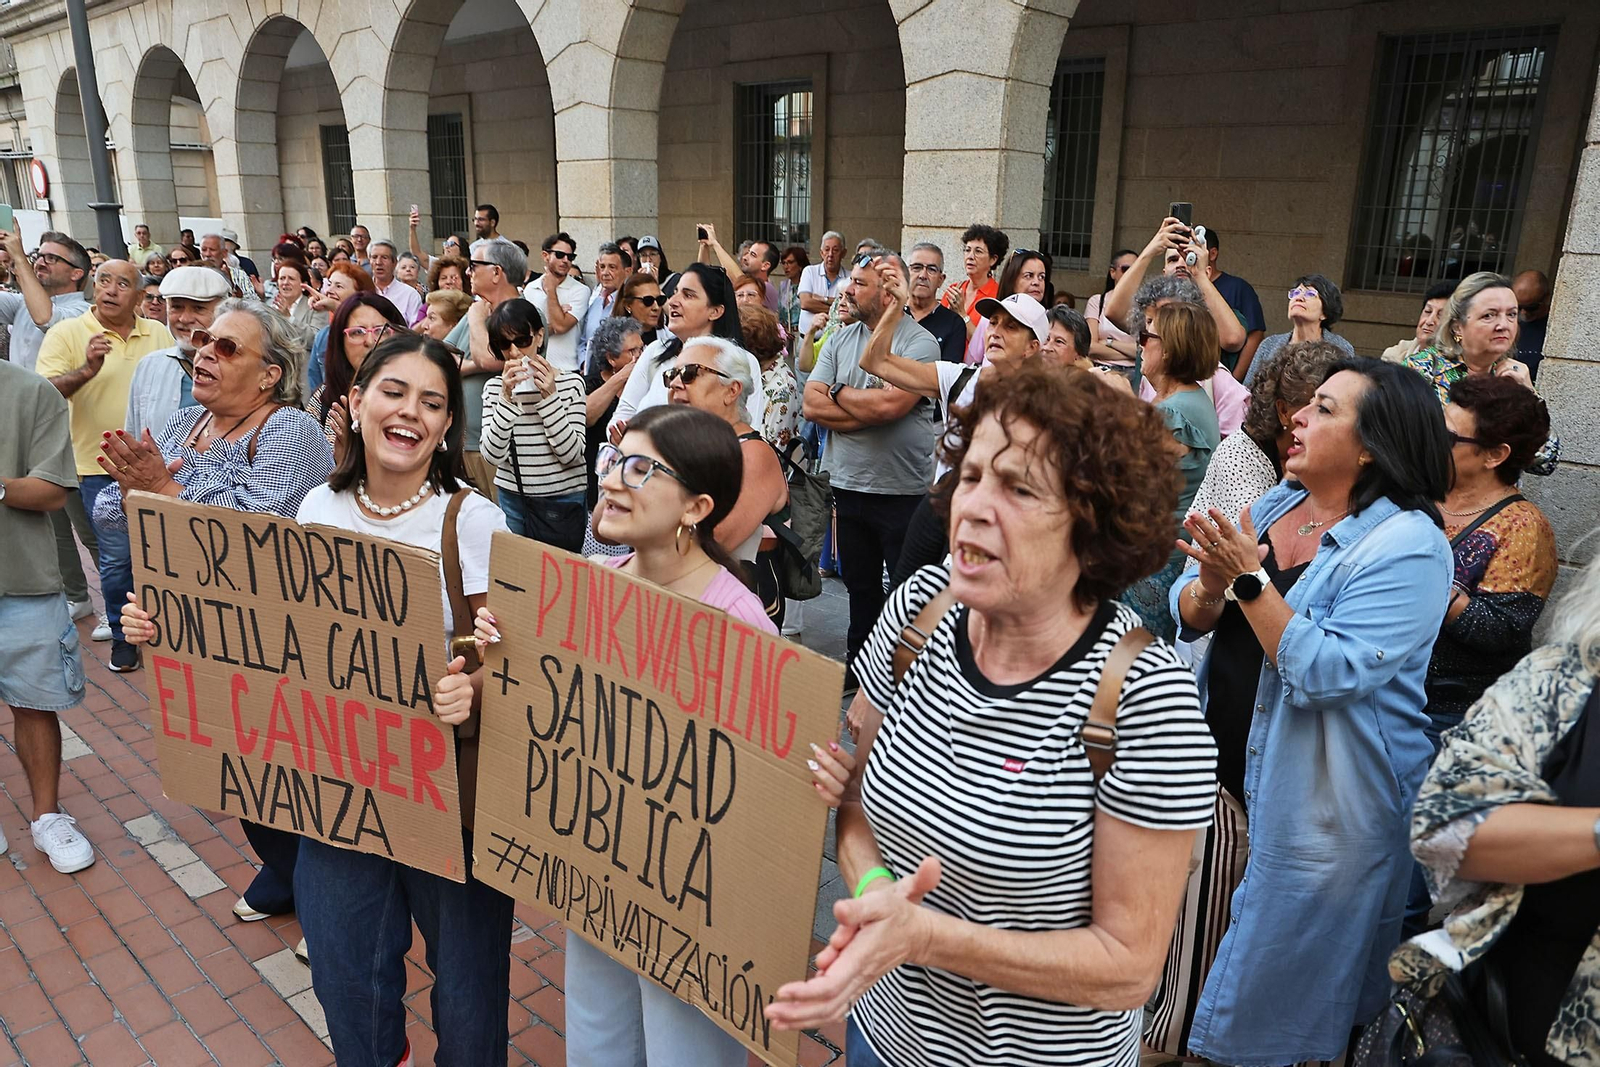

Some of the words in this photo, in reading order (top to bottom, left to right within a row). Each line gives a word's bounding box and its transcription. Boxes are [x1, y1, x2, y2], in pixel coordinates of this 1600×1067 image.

[138, 508, 179, 578] EL
[189, 516, 242, 591] SR.
[243, 522, 408, 627] MORENO
[141, 584, 307, 680] BONILLA
[327, 622, 438, 717] CALLA
[536, 550, 800, 760] PINKWASHING
[152, 655, 213, 748] EL
[231, 673, 448, 813] CÁNCER
[220, 752, 394, 857] AVANZA
[527, 654, 736, 825] SANIDAD
[525, 739, 713, 927] PÚBLICA
